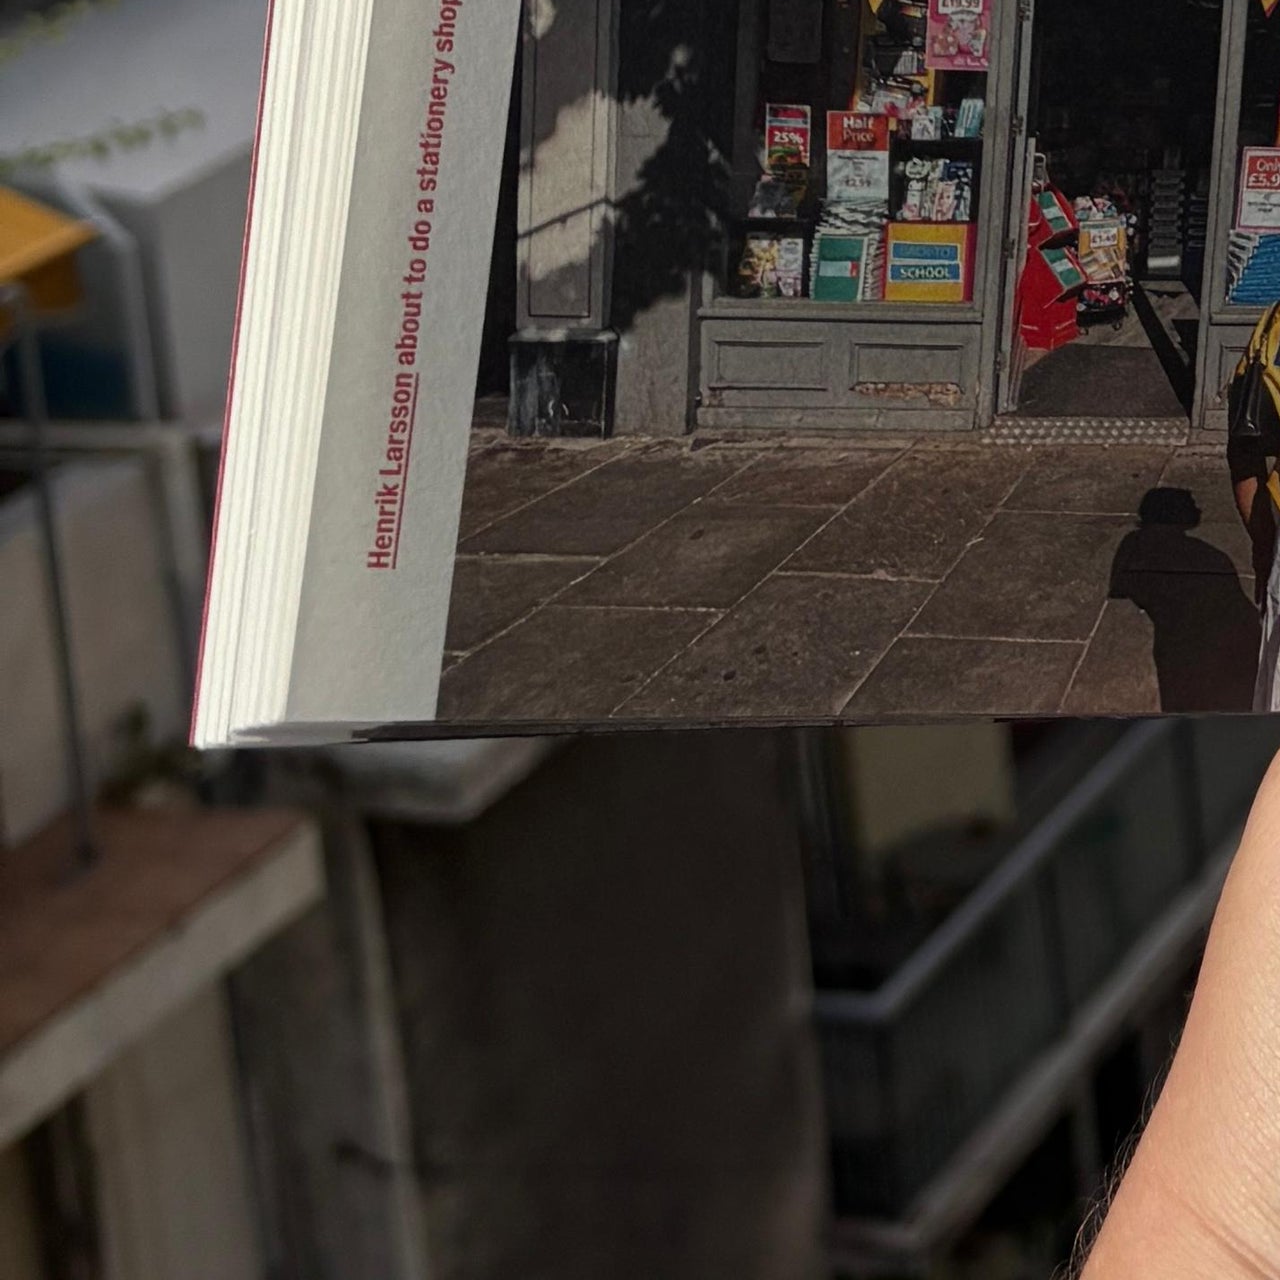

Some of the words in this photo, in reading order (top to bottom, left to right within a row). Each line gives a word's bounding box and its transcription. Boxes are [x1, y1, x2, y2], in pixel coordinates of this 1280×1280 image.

[416, 57, 456, 192] stationery
[842, 116, 875, 130] Half
[843, 128, 875, 142] Price
[773, 130, 804, 145] 25%
[417, 198, 434, 213] a
[408, 220, 432, 251] do
[403, 258, 427, 285] to
[899, 266, 951, 279] SCHOOL
[394, 291, 423, 366] about
[382, 372, 415, 476] Larsson
[366, 481, 400, 570] Henrik
